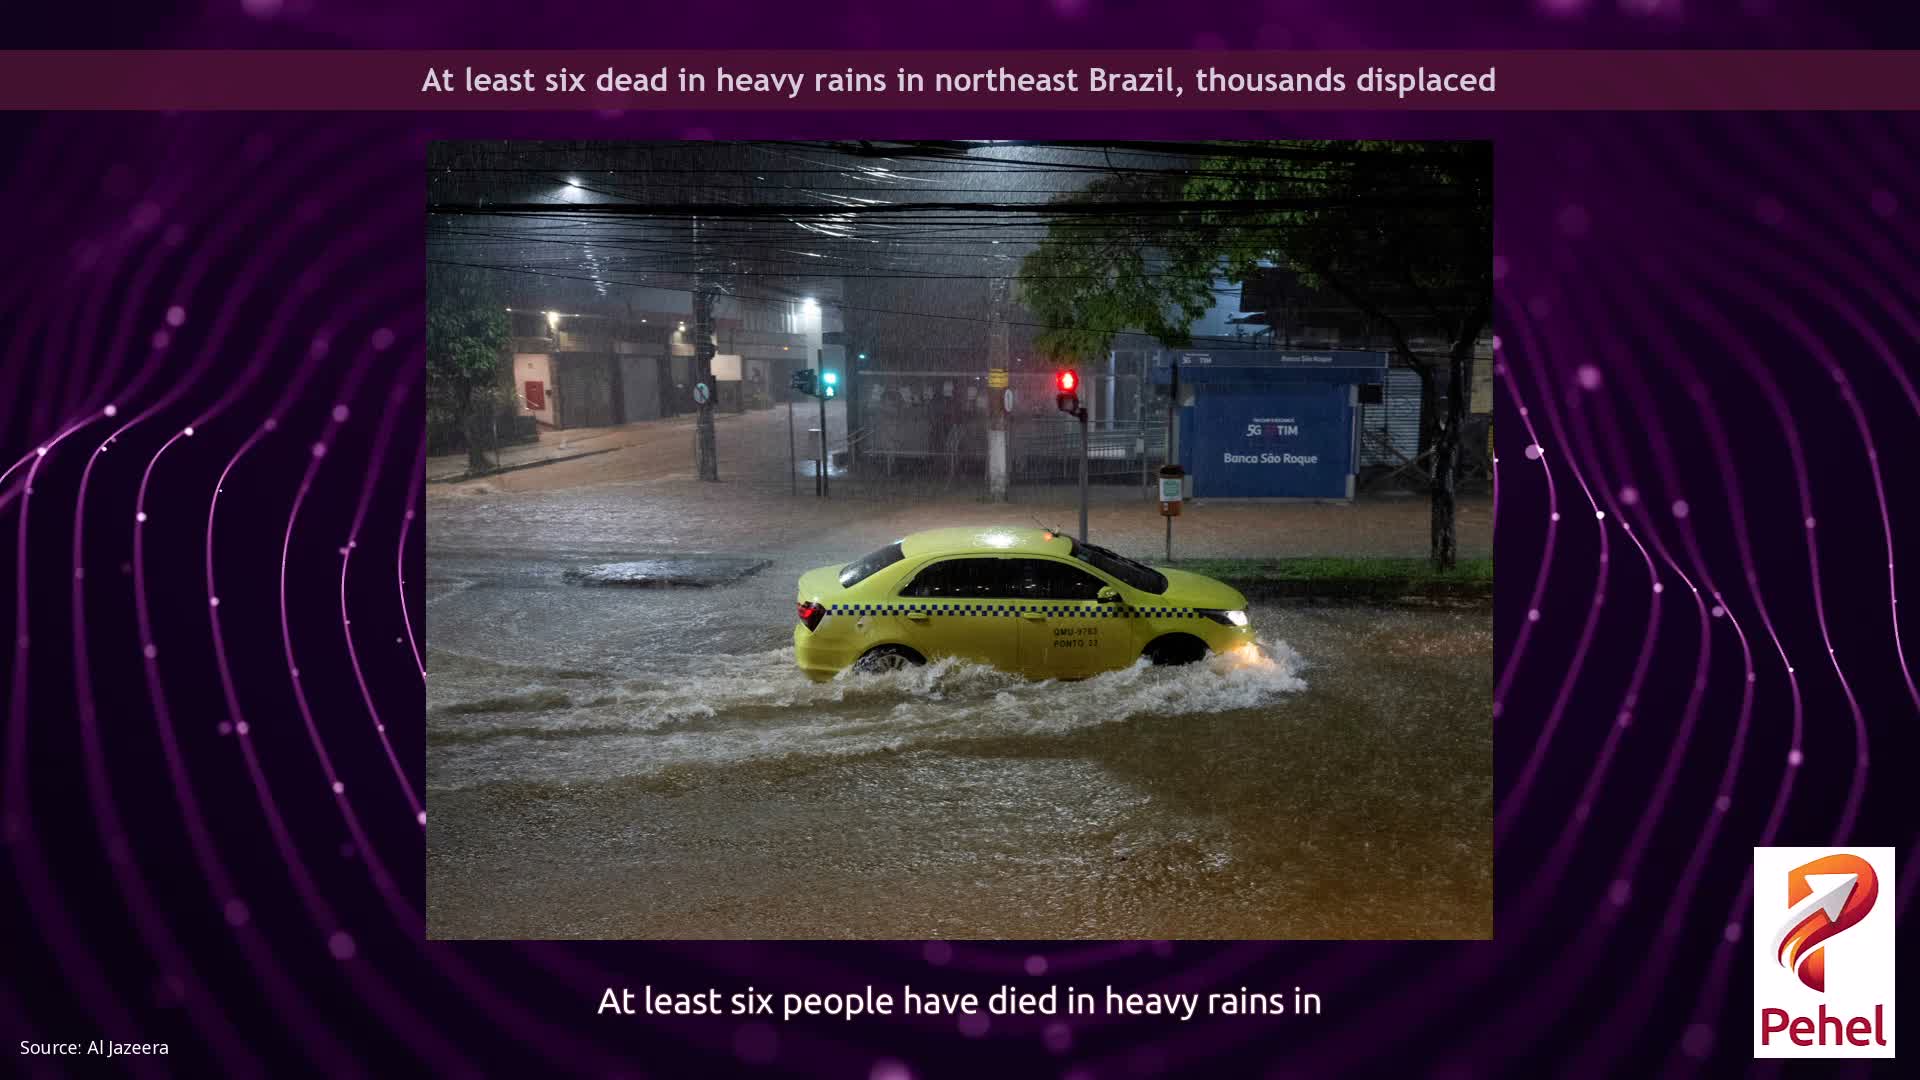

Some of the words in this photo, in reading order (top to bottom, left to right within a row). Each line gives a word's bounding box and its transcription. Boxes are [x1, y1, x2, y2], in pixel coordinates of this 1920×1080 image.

[1246, 424, 1262, 437] 5G
[1277, 425, 1298, 436] TIM
[1223, 453, 1258, 464] Banca
[1260, 453, 1281, 464] São
[1283, 453, 1318, 467] Roque
[1054, 639, 1085, 648] PONTO
